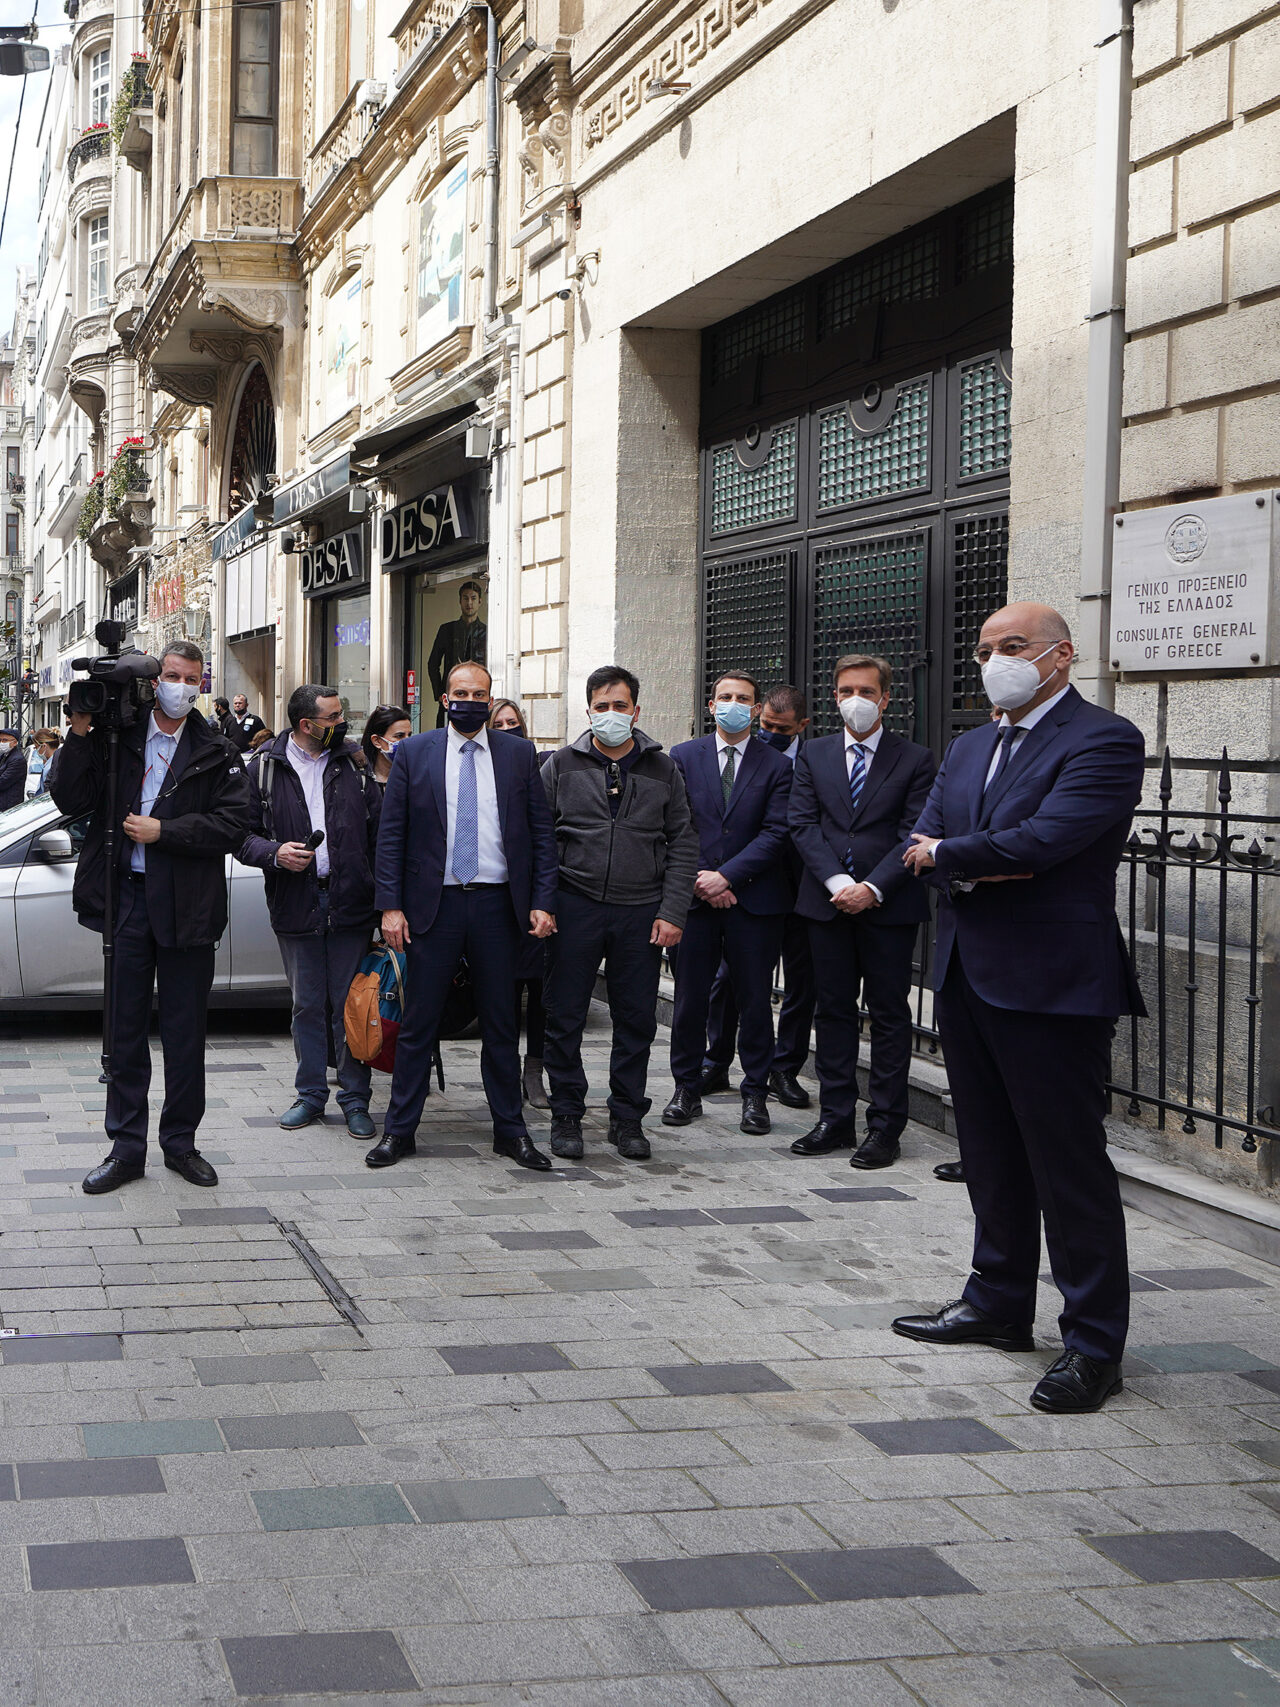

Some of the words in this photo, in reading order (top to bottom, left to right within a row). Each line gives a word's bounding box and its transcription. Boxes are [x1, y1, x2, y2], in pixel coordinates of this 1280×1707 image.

[289, 471, 326, 514] DESA
[381, 484, 463, 567] DESA
[301, 532, 355, 593] DESA
[1127, 581, 1169, 598] ΓΕΝΙΚΟ
[1178, 573, 1248, 593] ΠΡΟΞΕΝΕΙΟ
[1138, 600, 1161, 615] ΤΗΣ
[1167, 594, 1234, 613] ΕΛΛΑΔΟΣ
[1116, 626, 1184, 643] CONSULATE
[1193, 621, 1257, 639] GENERAL
[1144, 645, 1160, 659] OF
[1167, 643, 1223, 658] GREECE
